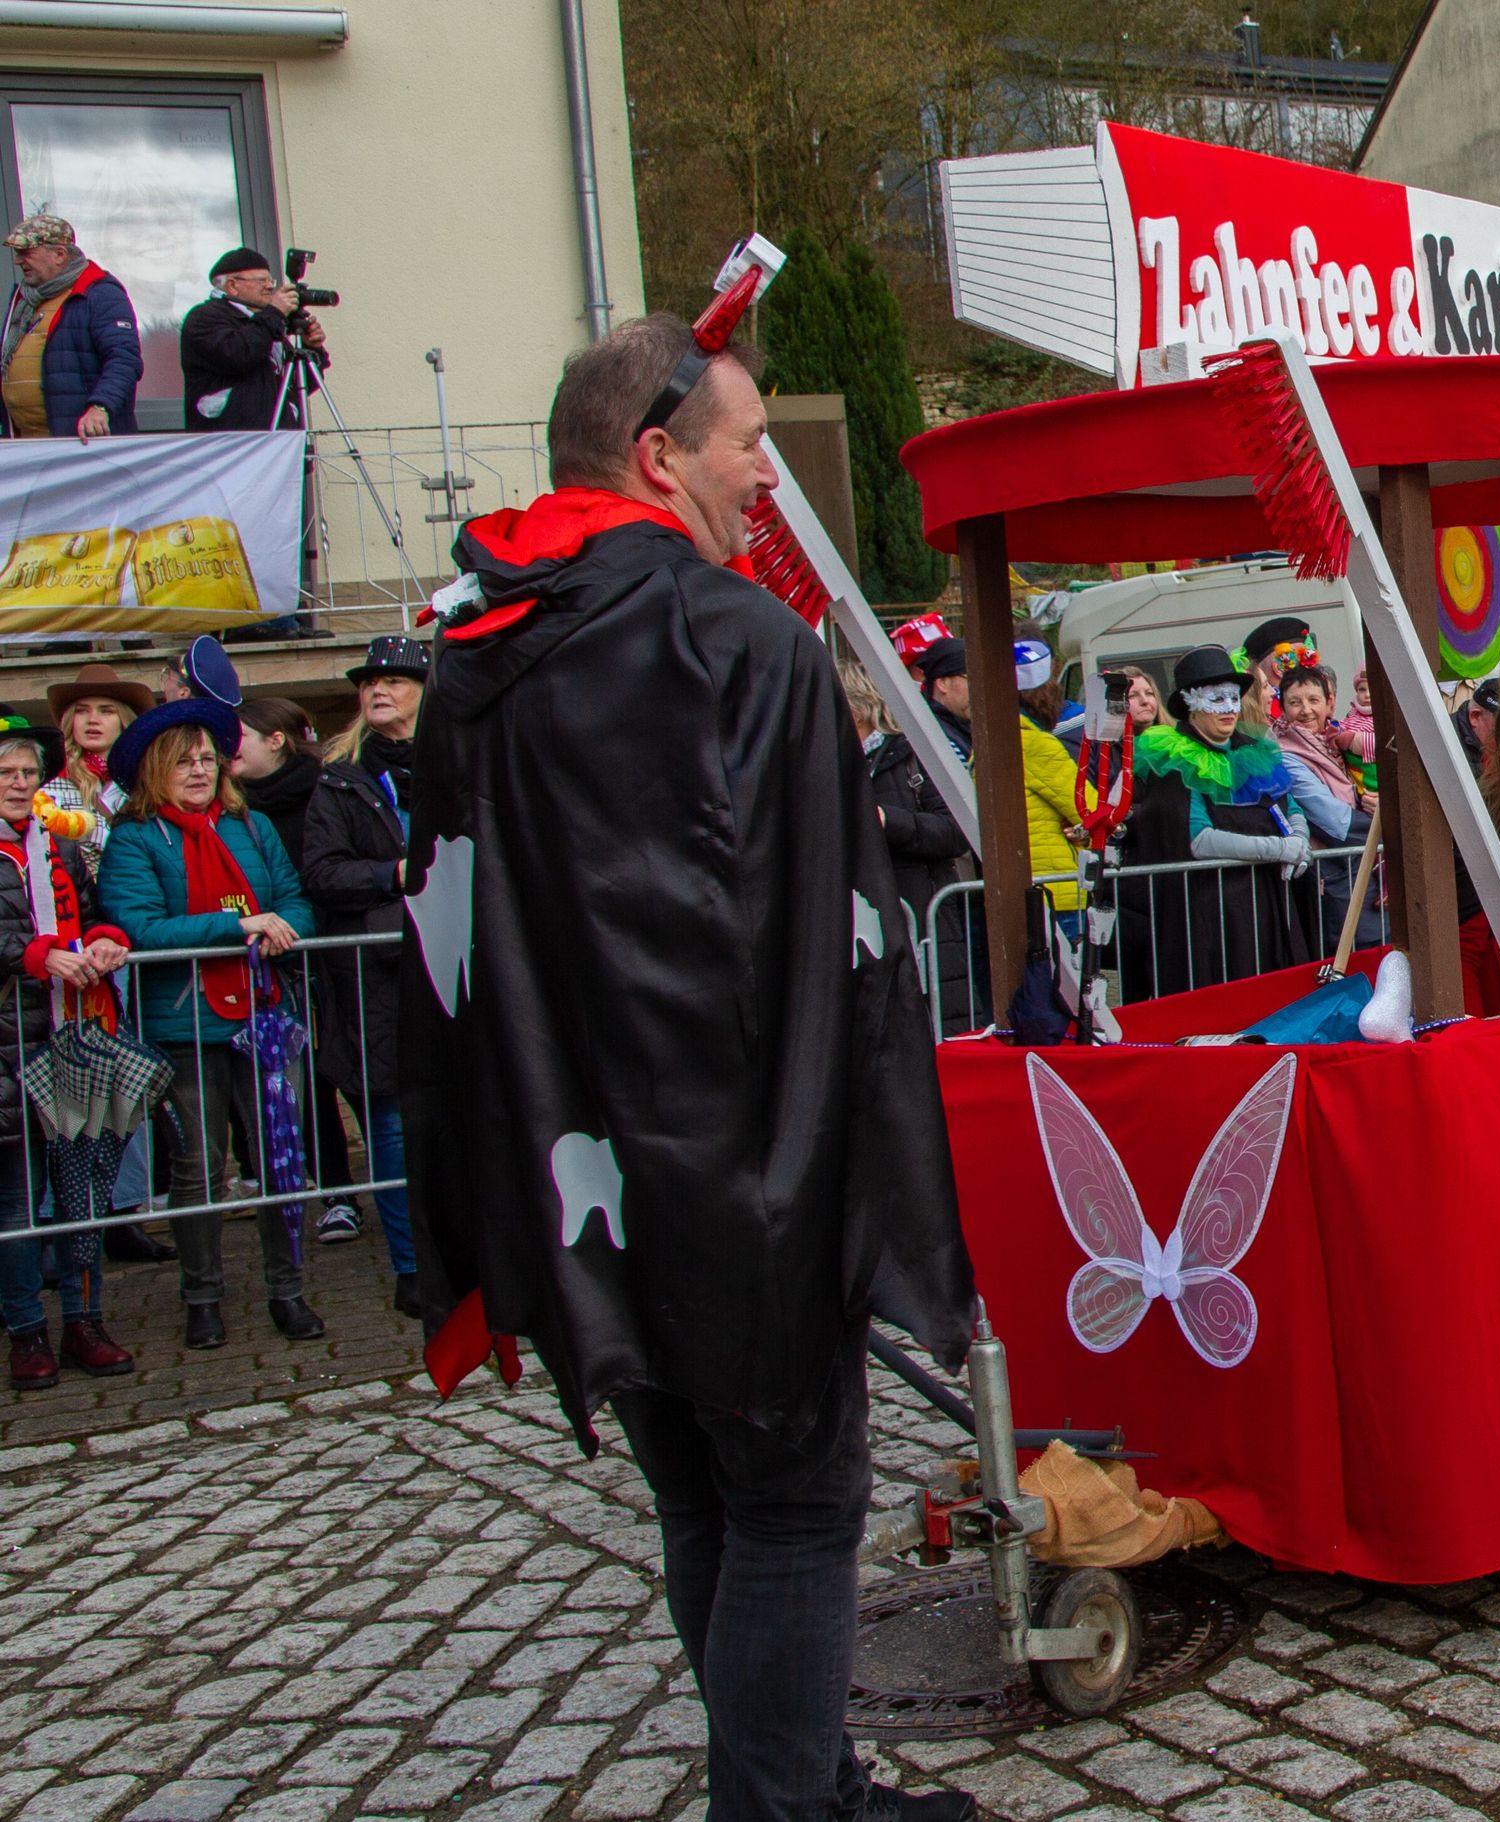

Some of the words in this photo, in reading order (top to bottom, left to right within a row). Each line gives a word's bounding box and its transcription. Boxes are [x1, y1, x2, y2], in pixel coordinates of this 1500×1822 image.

[1139, 216, 1380, 356] Zahnfee
[1388, 266, 1424, 356] &
[142, 553, 241, 594] Bitburger
[220, 895, 246, 907] UHU
